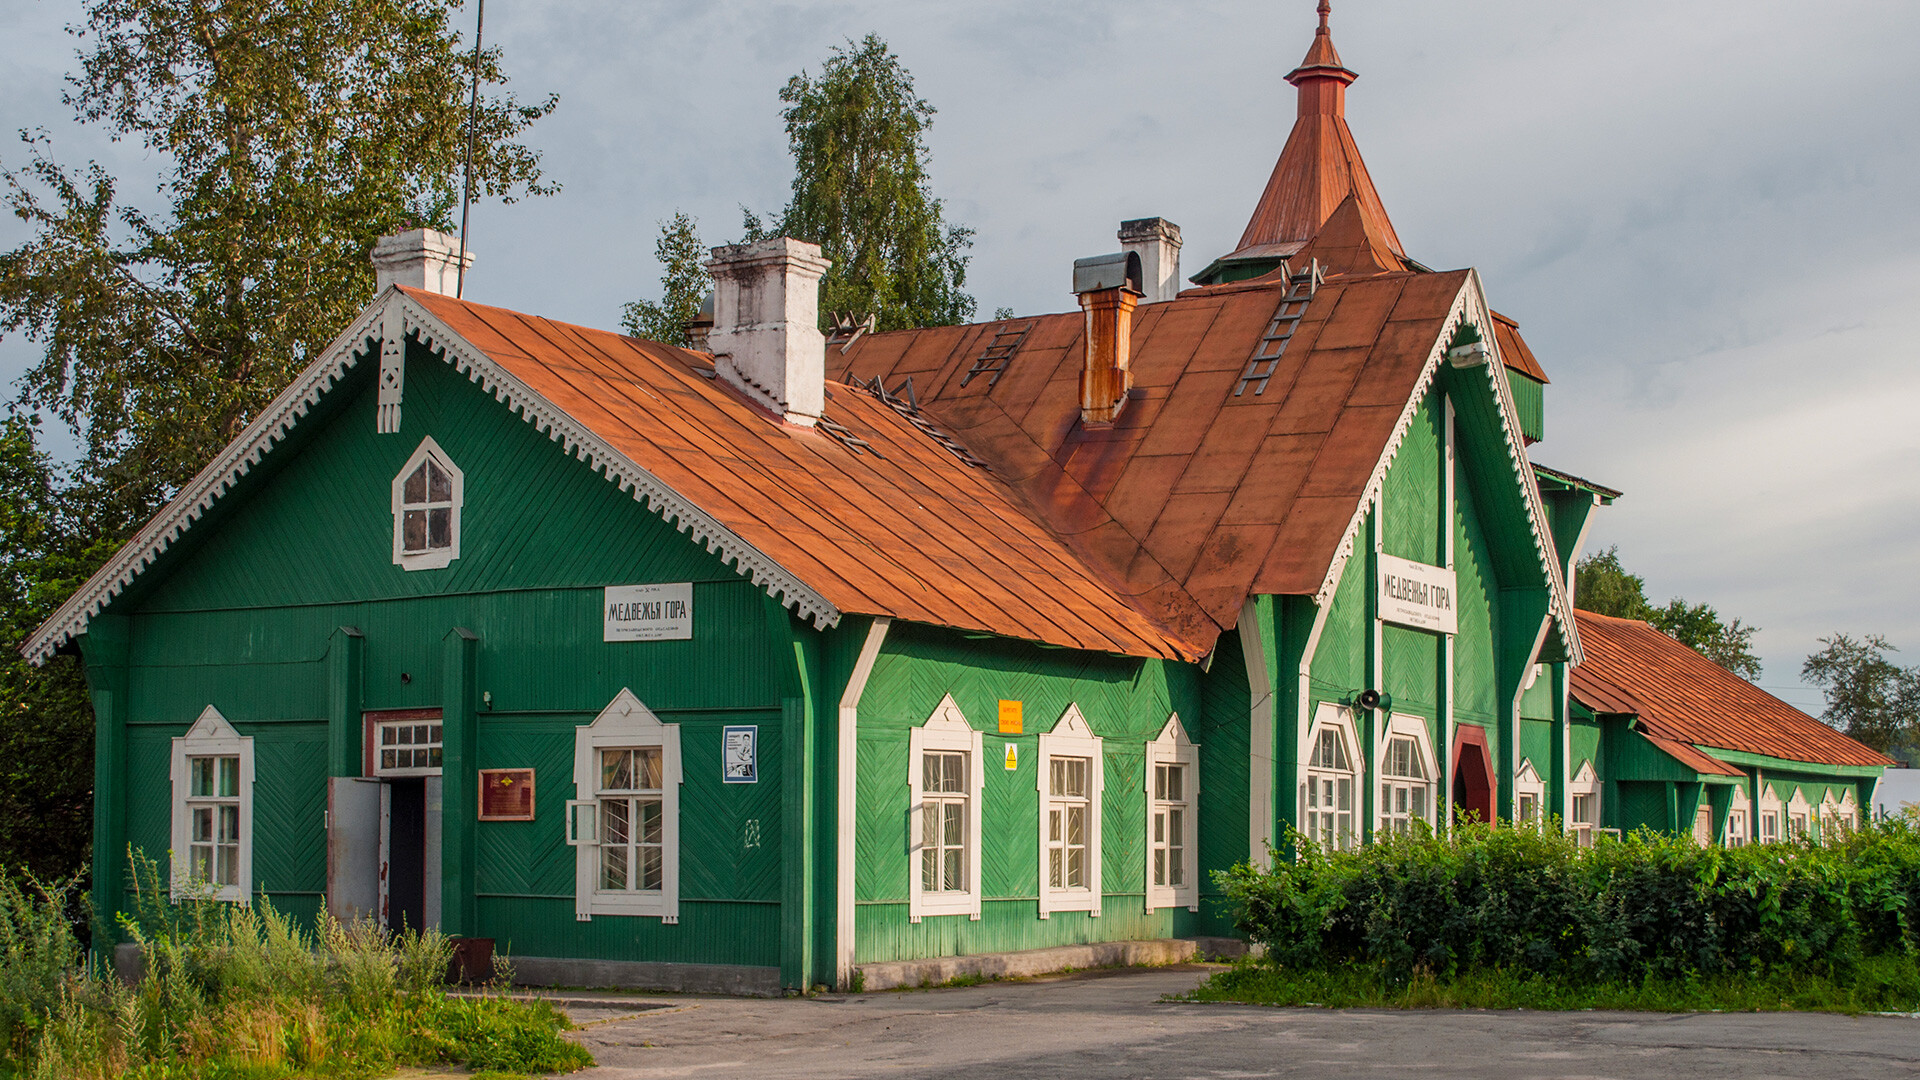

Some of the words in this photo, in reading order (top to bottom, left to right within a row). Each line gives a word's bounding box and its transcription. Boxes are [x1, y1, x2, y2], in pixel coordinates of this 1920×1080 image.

[1384, 573, 1428, 606] МЕДВЕЖЬЯ
[1431, 585, 1451, 611] ГОРА
[608, 602, 661, 621] МЕДВЕЖЬЯ
[665, 600, 687, 619] ГОРА
